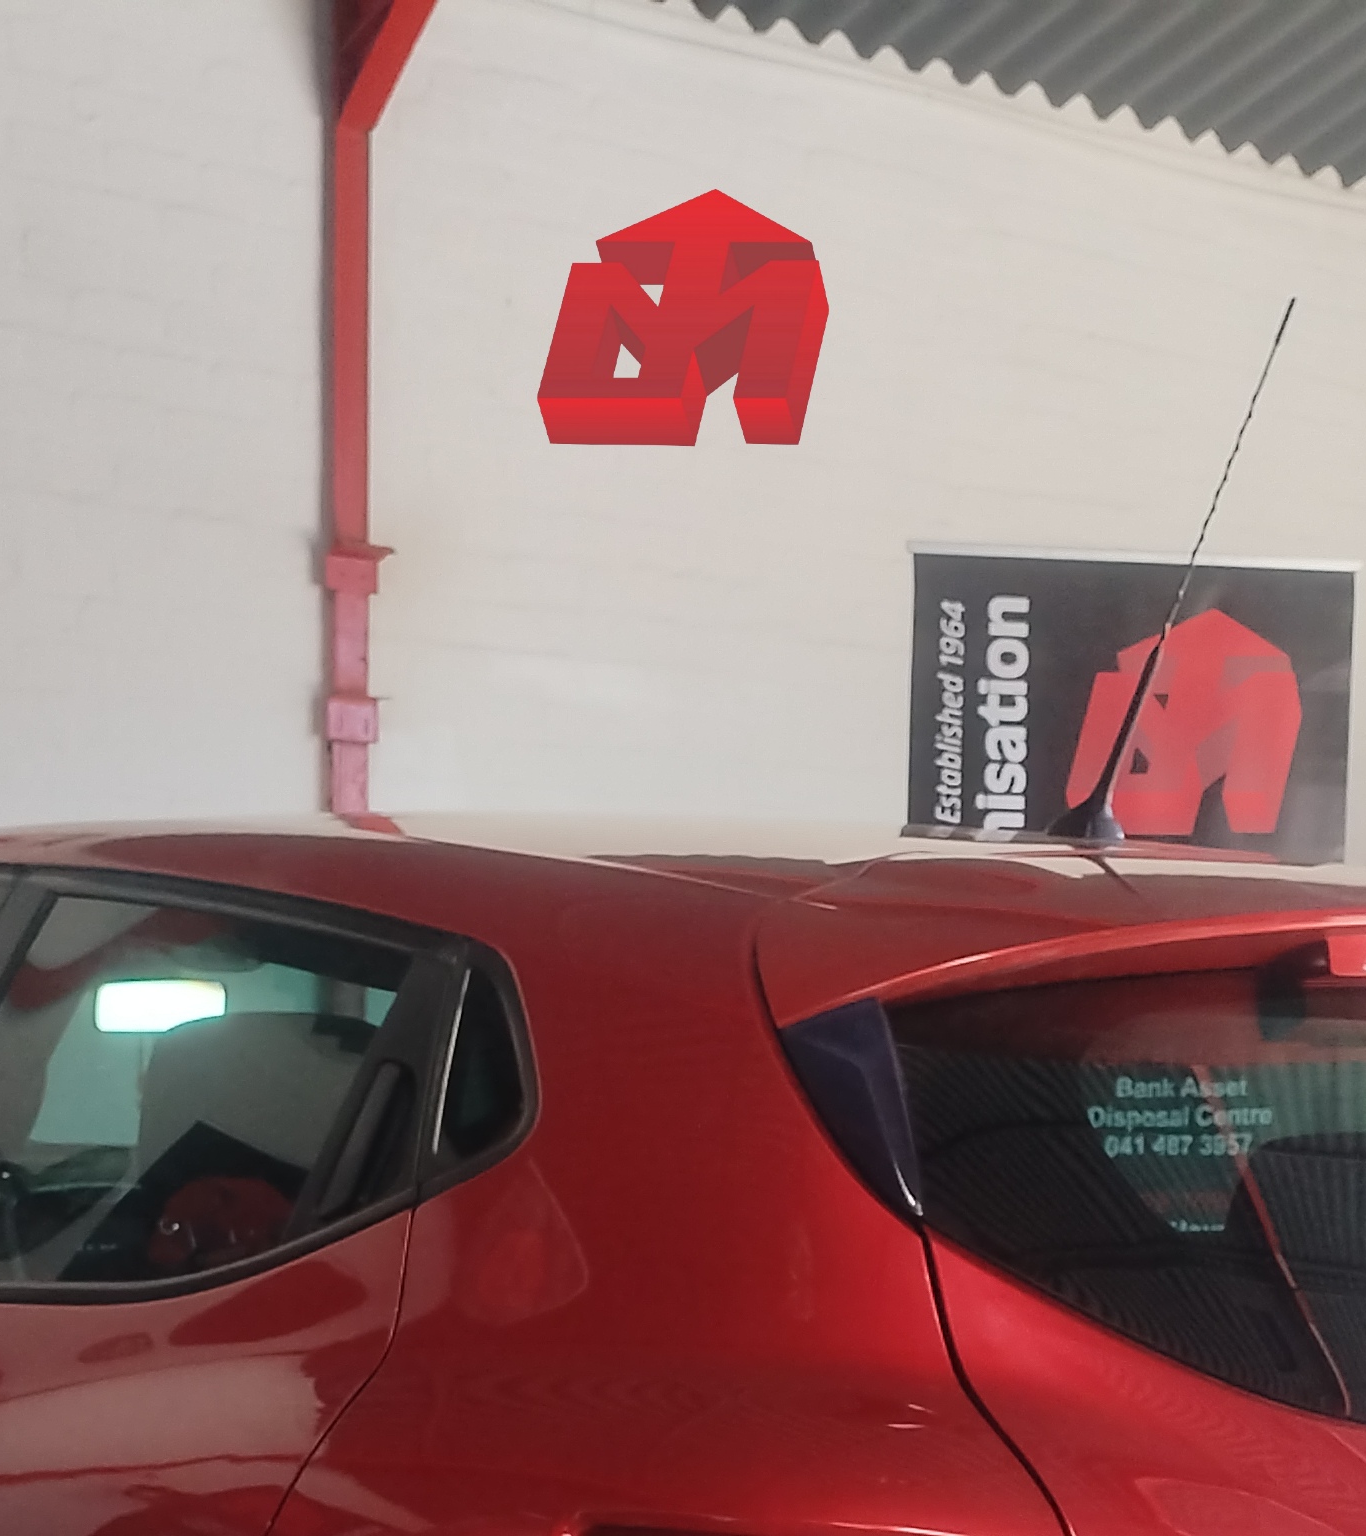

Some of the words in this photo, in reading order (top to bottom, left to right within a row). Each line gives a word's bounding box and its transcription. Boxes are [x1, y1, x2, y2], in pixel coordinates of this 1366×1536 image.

[939, 599, 966, 666] 1964
[935, 672, 965, 824] Established
[1116, 1076, 1175, 1097] Bank
[1180, 1076, 1248, 1097] Asset
[1088, 1106, 1189, 1132] Disposal
[1195, 1104, 1272, 1127] Centre
[1105, 1134, 1145, 1157] 041
